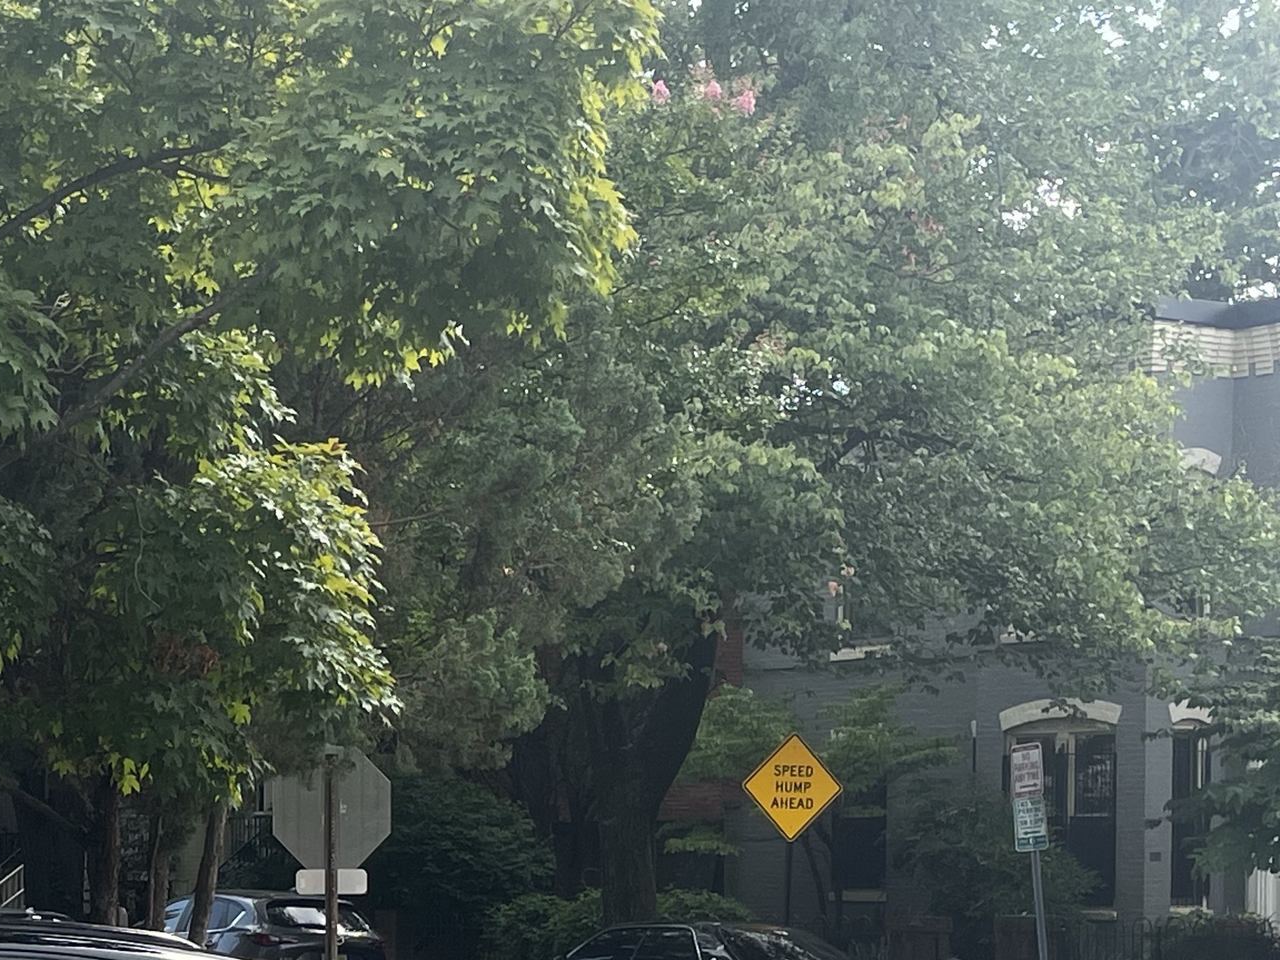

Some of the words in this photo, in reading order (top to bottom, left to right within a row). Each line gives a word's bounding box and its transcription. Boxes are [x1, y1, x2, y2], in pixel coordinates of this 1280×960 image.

[773, 764, 814, 778] SPEED
[775, 781, 812, 793] HUMP
[770, 796, 814, 810] AHEAD
